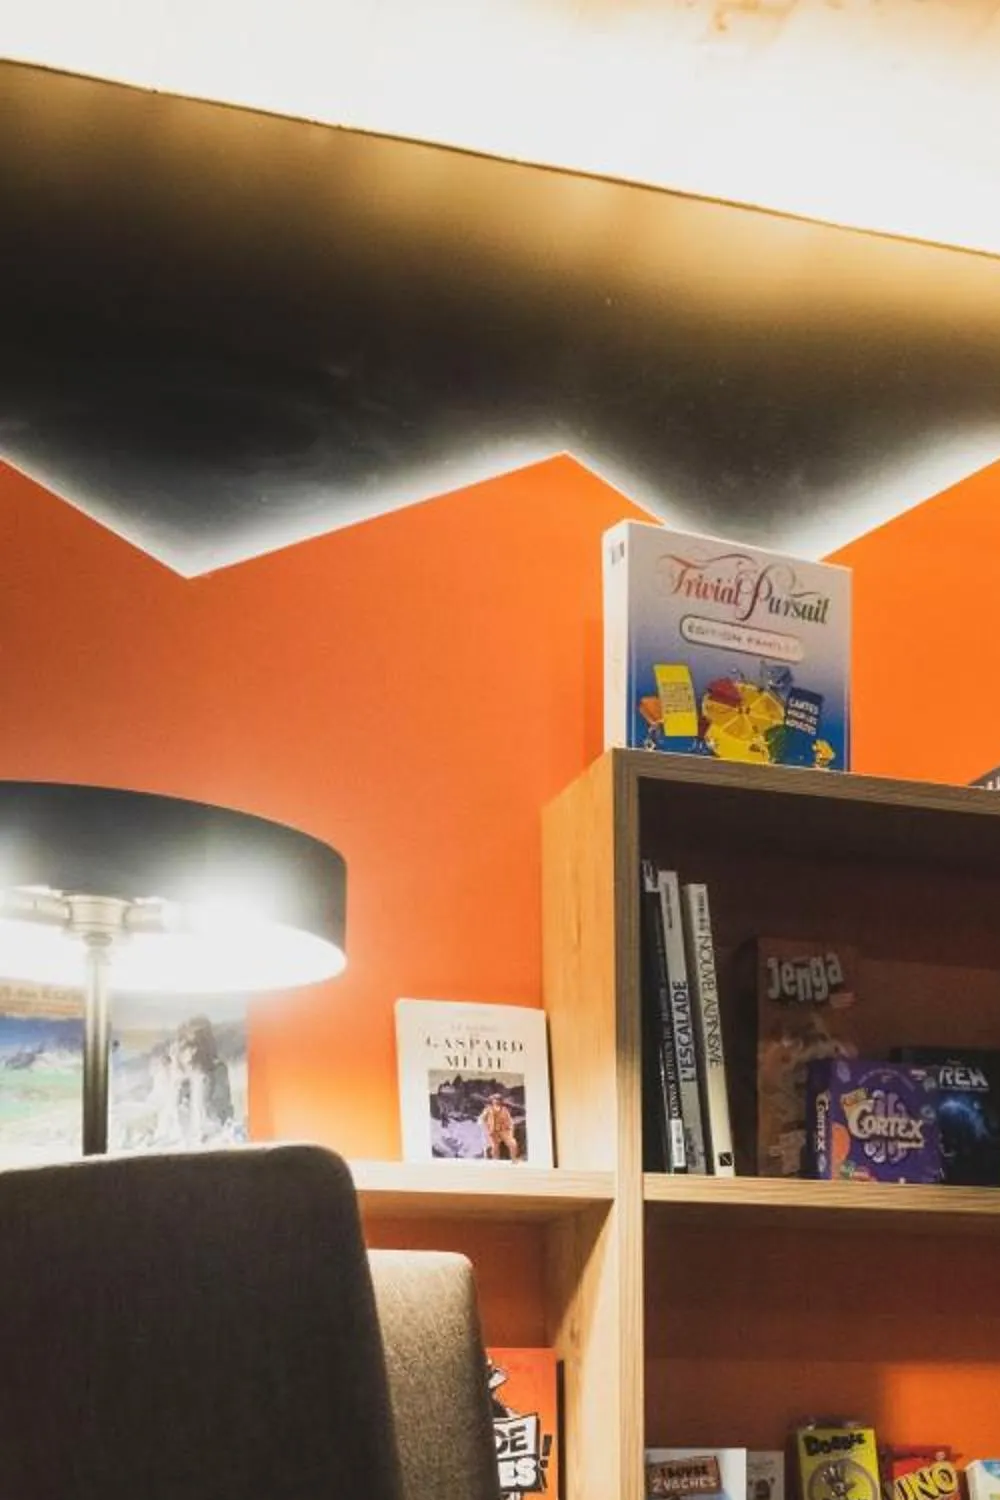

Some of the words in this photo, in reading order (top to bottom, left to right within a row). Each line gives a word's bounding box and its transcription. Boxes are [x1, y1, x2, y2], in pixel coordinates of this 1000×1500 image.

[662, 555, 744, 608] Trivial
[736, 562, 830, 625] Pursuit
[766, 952, 844, 1000] Jenga
[672, 980, 696, 1083] L'ESCALADE
[939, 1066, 989, 1087] REW
